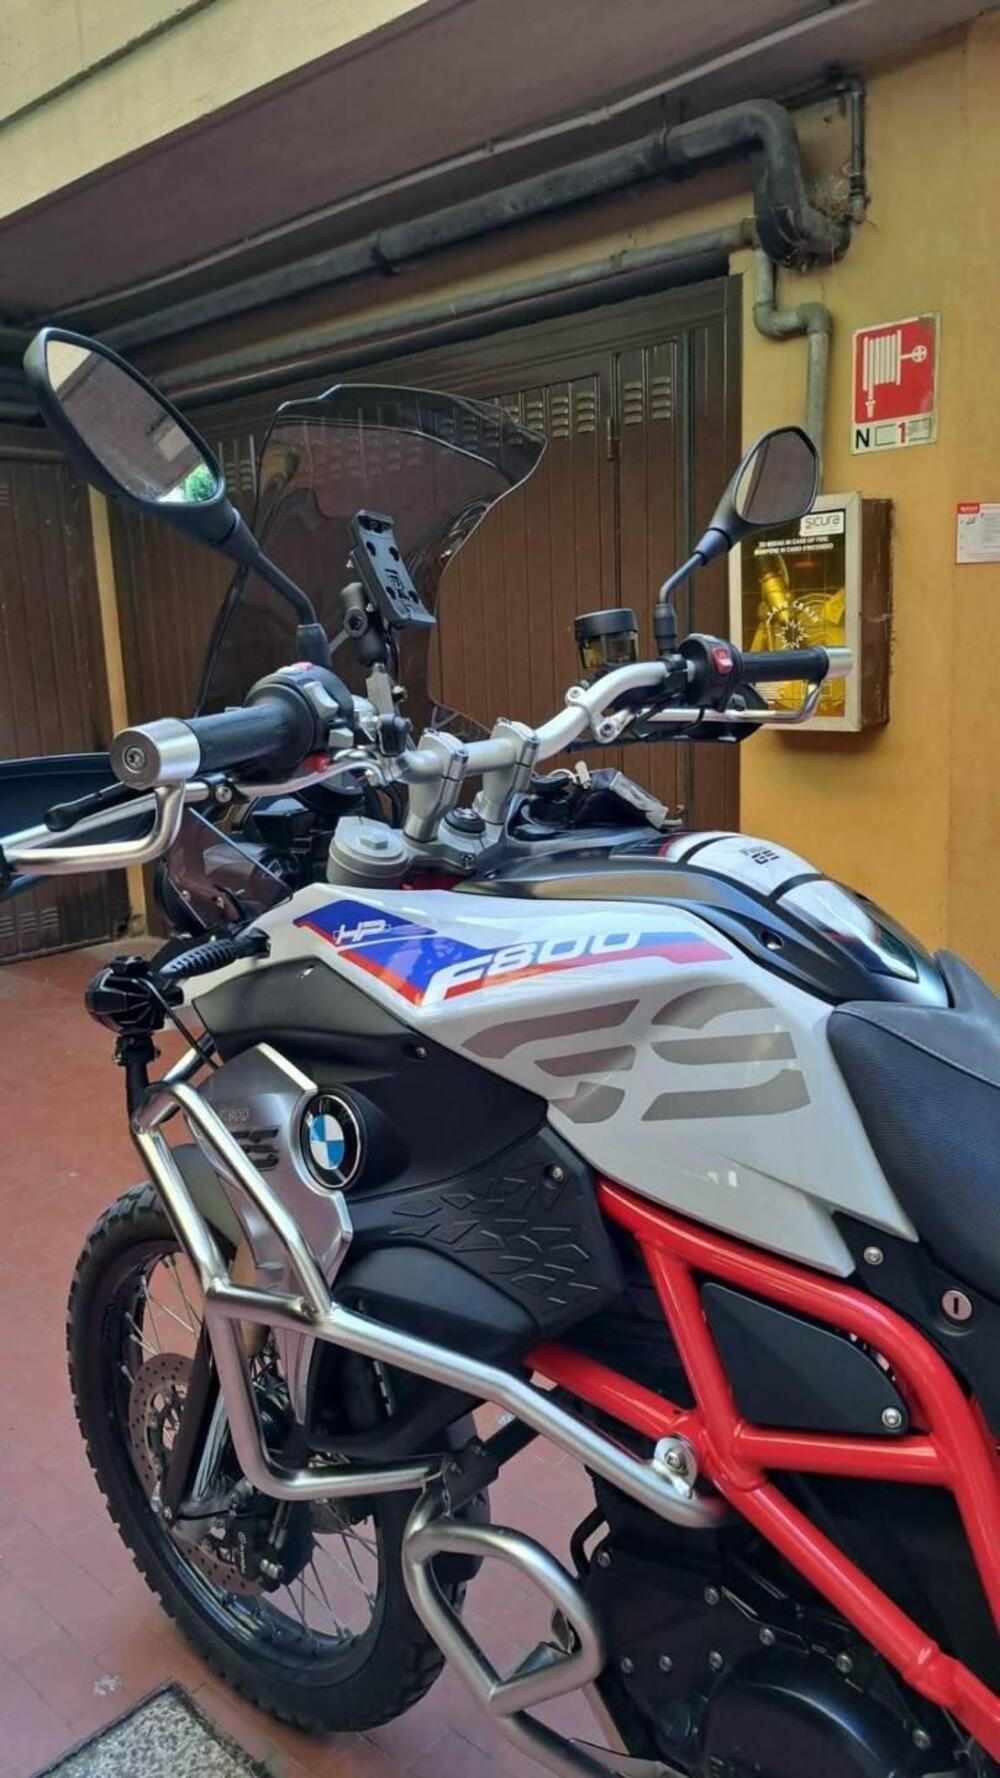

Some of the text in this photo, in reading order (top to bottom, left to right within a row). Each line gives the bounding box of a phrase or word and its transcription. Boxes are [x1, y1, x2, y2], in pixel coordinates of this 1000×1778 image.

[856, 422, 906, 449] N 1
[335, 919, 386, 945] HP
[420, 928, 642, 1005] F800
